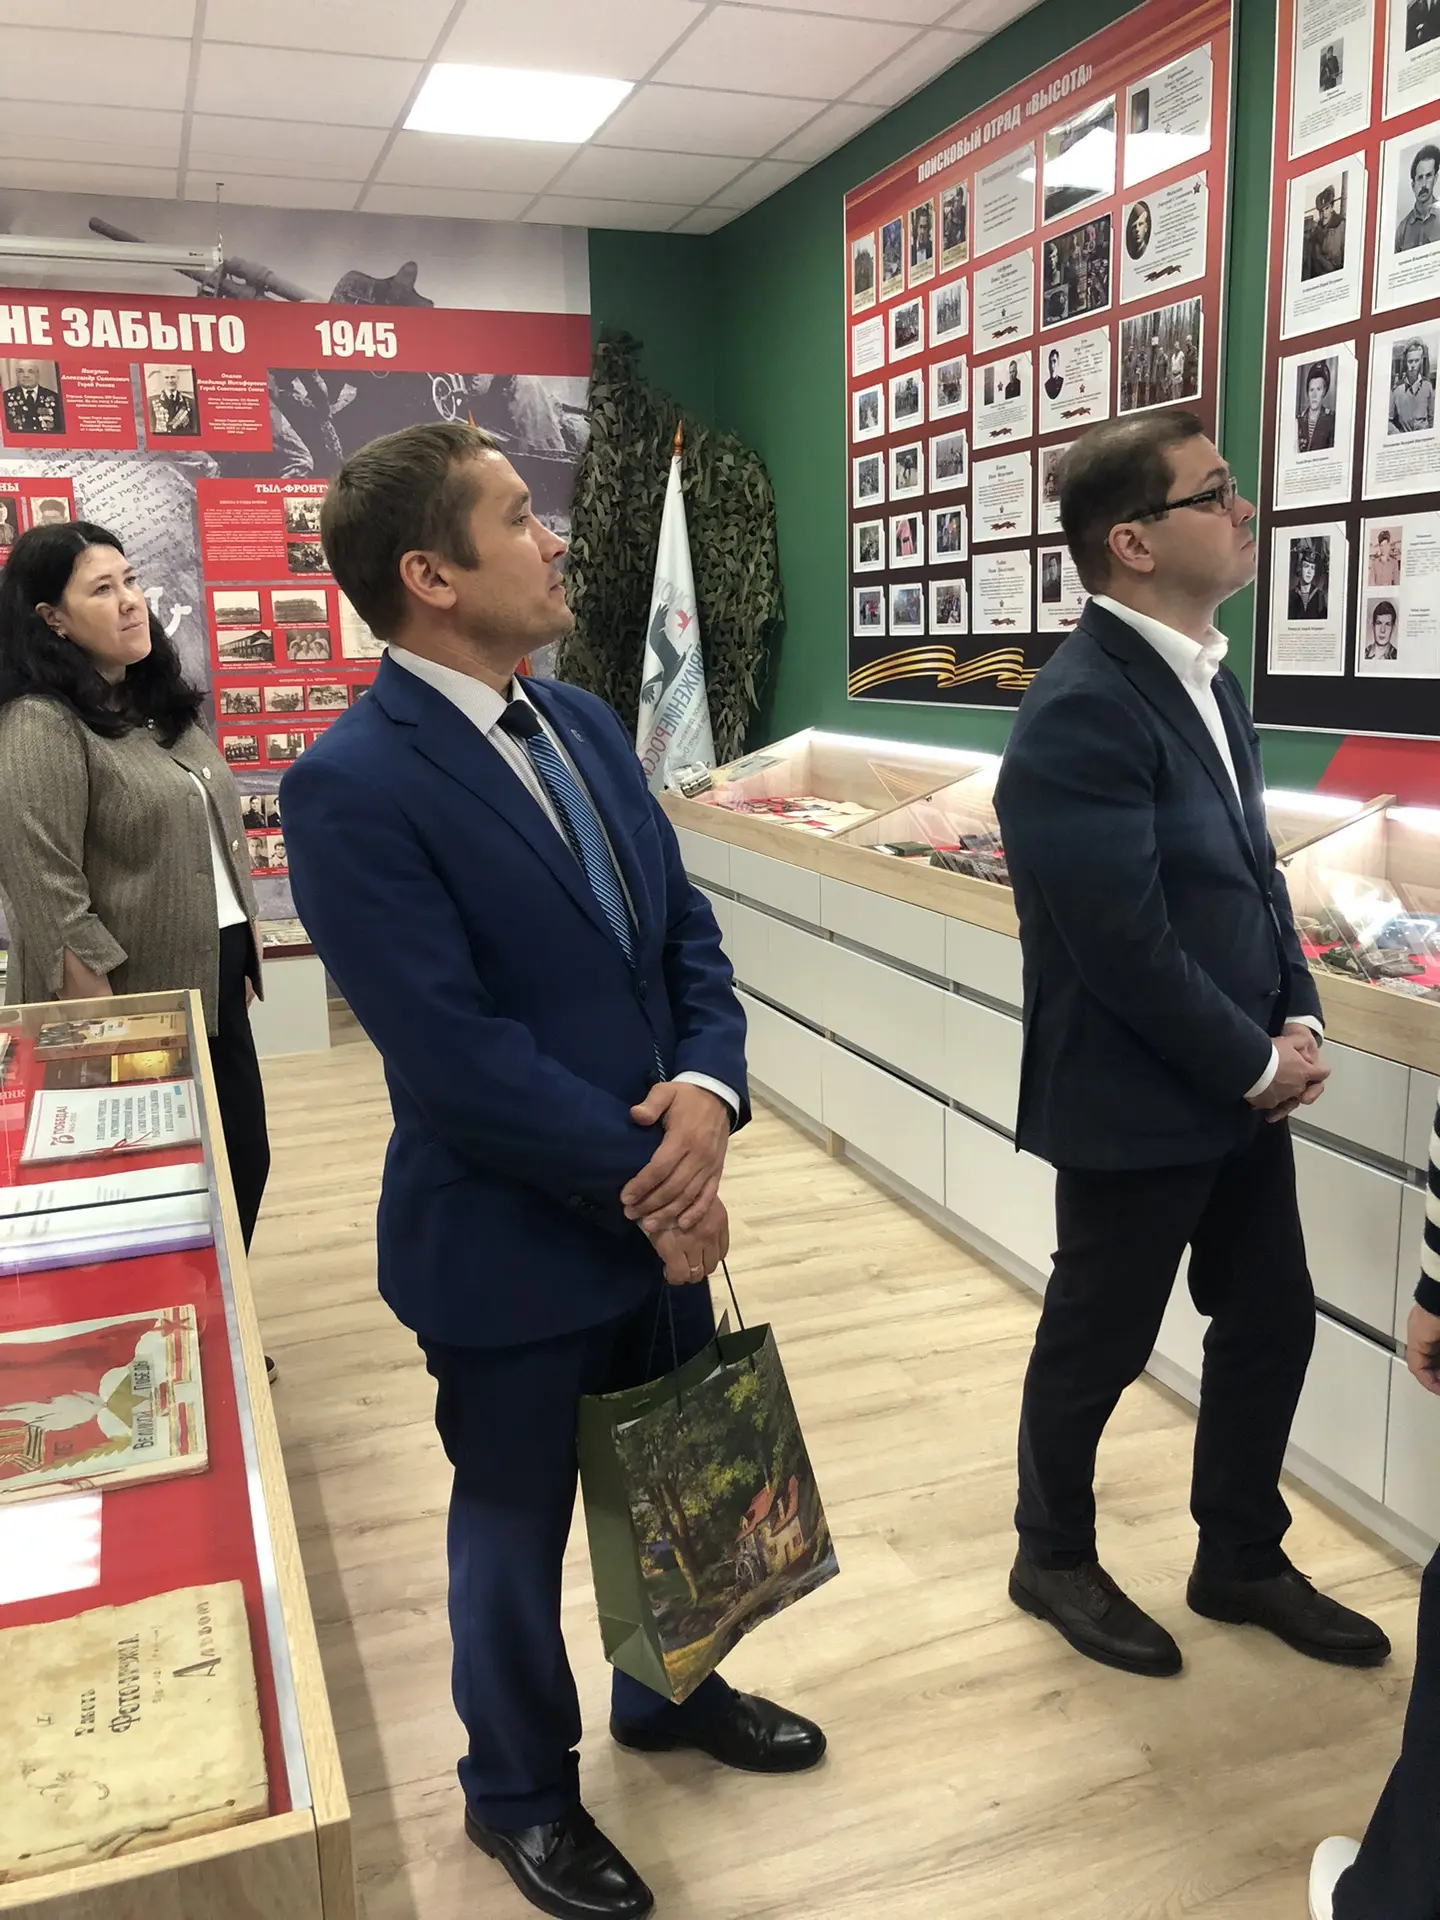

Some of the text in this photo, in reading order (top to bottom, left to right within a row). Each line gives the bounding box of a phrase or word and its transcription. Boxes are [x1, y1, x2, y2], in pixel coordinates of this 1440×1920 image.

[918, 126, 981, 183] ПОИСКОВЫЙ
[983, 103, 1021, 144] ОТРЯД
[1025, 64, 1093, 117] «ВЫСОТА»
[0, 305, 246, 354] НЕ ЗАБЫТО
[314, 320, 398, 359] 1945
